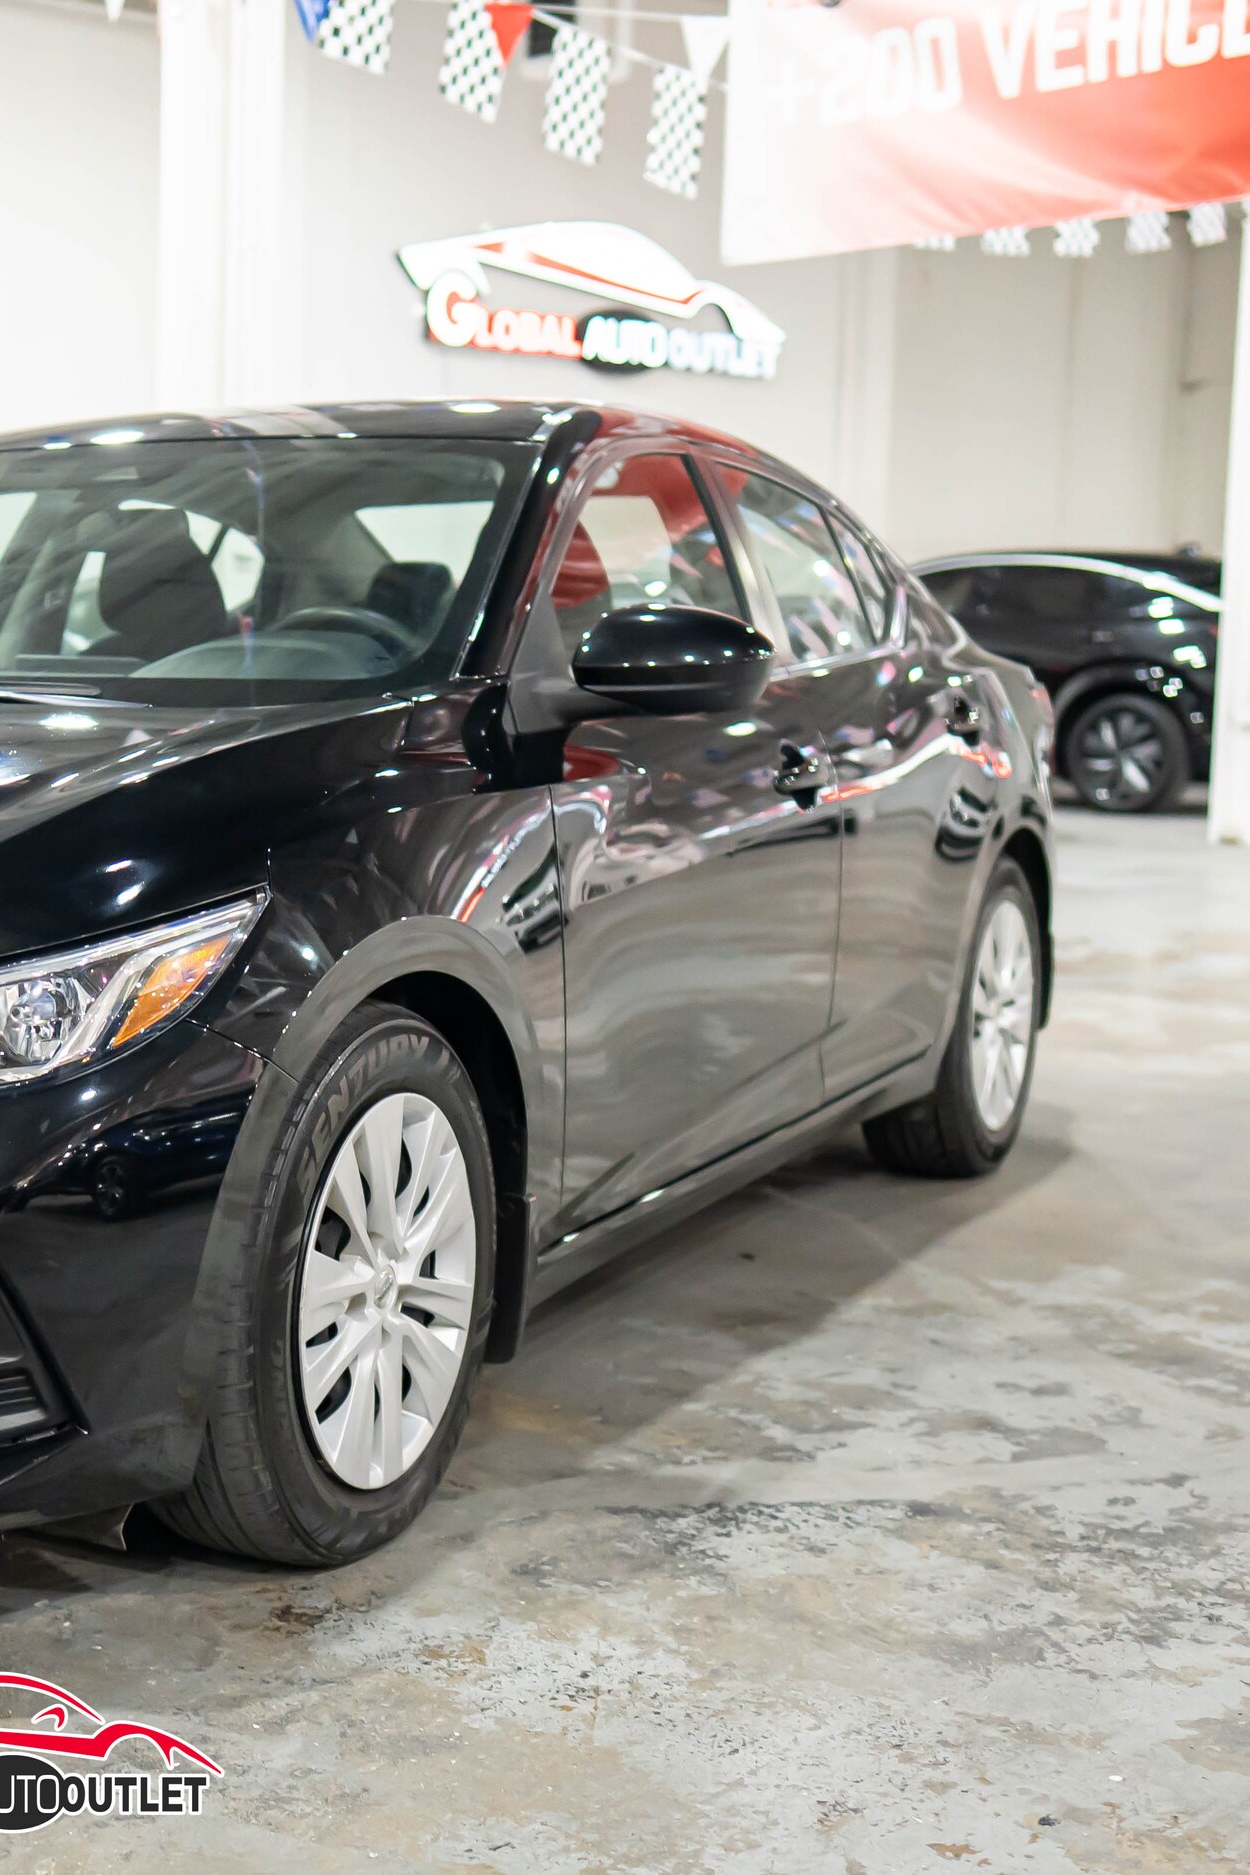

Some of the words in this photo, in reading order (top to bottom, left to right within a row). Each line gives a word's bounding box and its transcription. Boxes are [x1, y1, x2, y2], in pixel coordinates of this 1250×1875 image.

[426, 269, 582, 360] GLOBAL
[581, 313, 669, 369] AUTO
[667, 326, 783, 380] OUTLET
